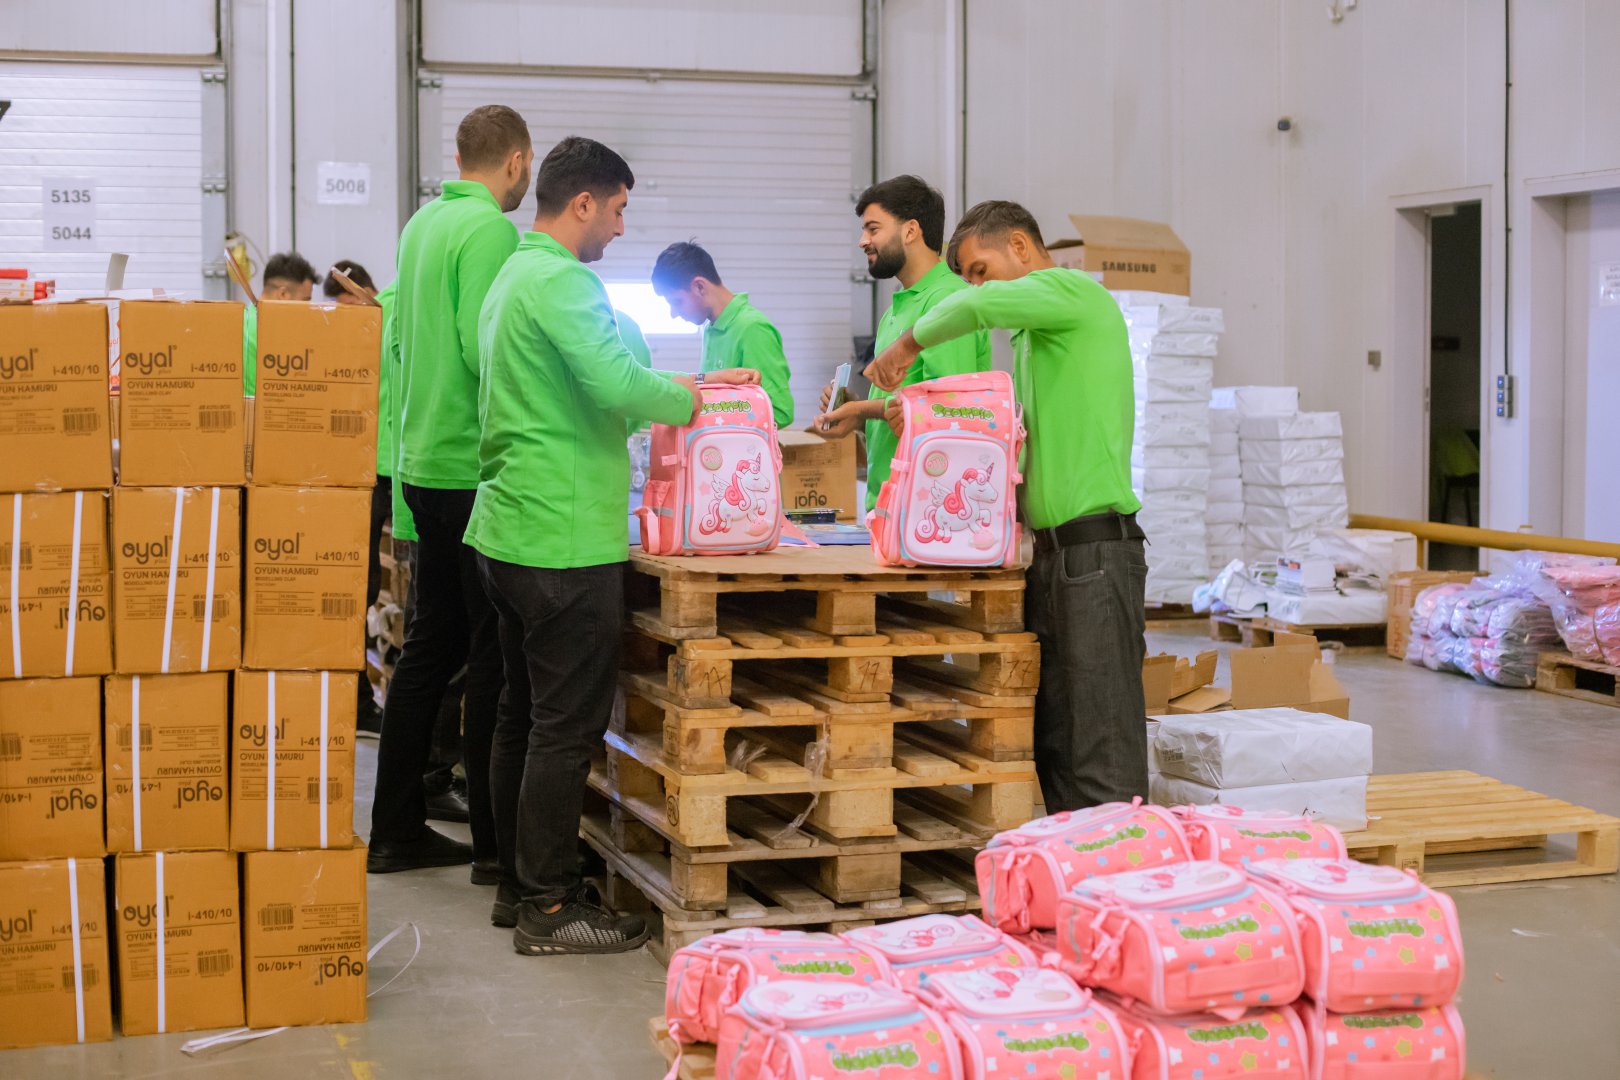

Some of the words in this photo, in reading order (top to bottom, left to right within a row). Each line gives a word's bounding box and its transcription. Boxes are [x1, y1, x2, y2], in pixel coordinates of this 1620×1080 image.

[325, 179, 366, 193] 5008
[51, 190, 91, 203] 5135
[52, 227, 92, 240] 5044
[1102, 261, 1157, 273] SAMSUNG
[125, 345, 172, 375] oyal
[263, 349, 309, 377] oyal
[17, 384, 58, 393] HAMURU
[127, 381, 154, 389] OYUN
[156, 381, 195, 389] HAMURU
[263, 382, 288, 391] OYUN
[290, 383, 328, 392] HAMURU
[794, 490, 827, 509] oyal
[122, 535, 168, 565] oyal
[254, 532, 300, 561] oyal
[123, 571, 149, 579] OYUN
[151, 570, 189, 579] HAMRU
[254, 567, 279, 575] OYUN
[281, 567, 319, 576] HAMURU
[37, 585, 70, 595] AMURU
[78, 584, 103, 593] OYUN
[300, 736, 345, 747] i-41/10
[240, 753, 265, 761] OYUN
[271, 753, 304, 761] AMURU
[157, 766, 195, 775] HAMURU
[196, 765, 222, 774] OYUN
[27, 774, 67, 784] HAMURU
[68, 773, 94, 782] OYUN
[116, 782, 161, 794] i-41/10
[177, 780, 223, 809] oyal
[50, 788, 97, 819] oyal
[51, 921, 97, 935] i-41/10
[126, 933, 152, 942] OYUN
[17, 943, 56, 953] HAMURU
[297, 943, 335, 953] HAMURU
[337, 941, 361, 950] OYUN
[319, 955, 364, 985] oyal
